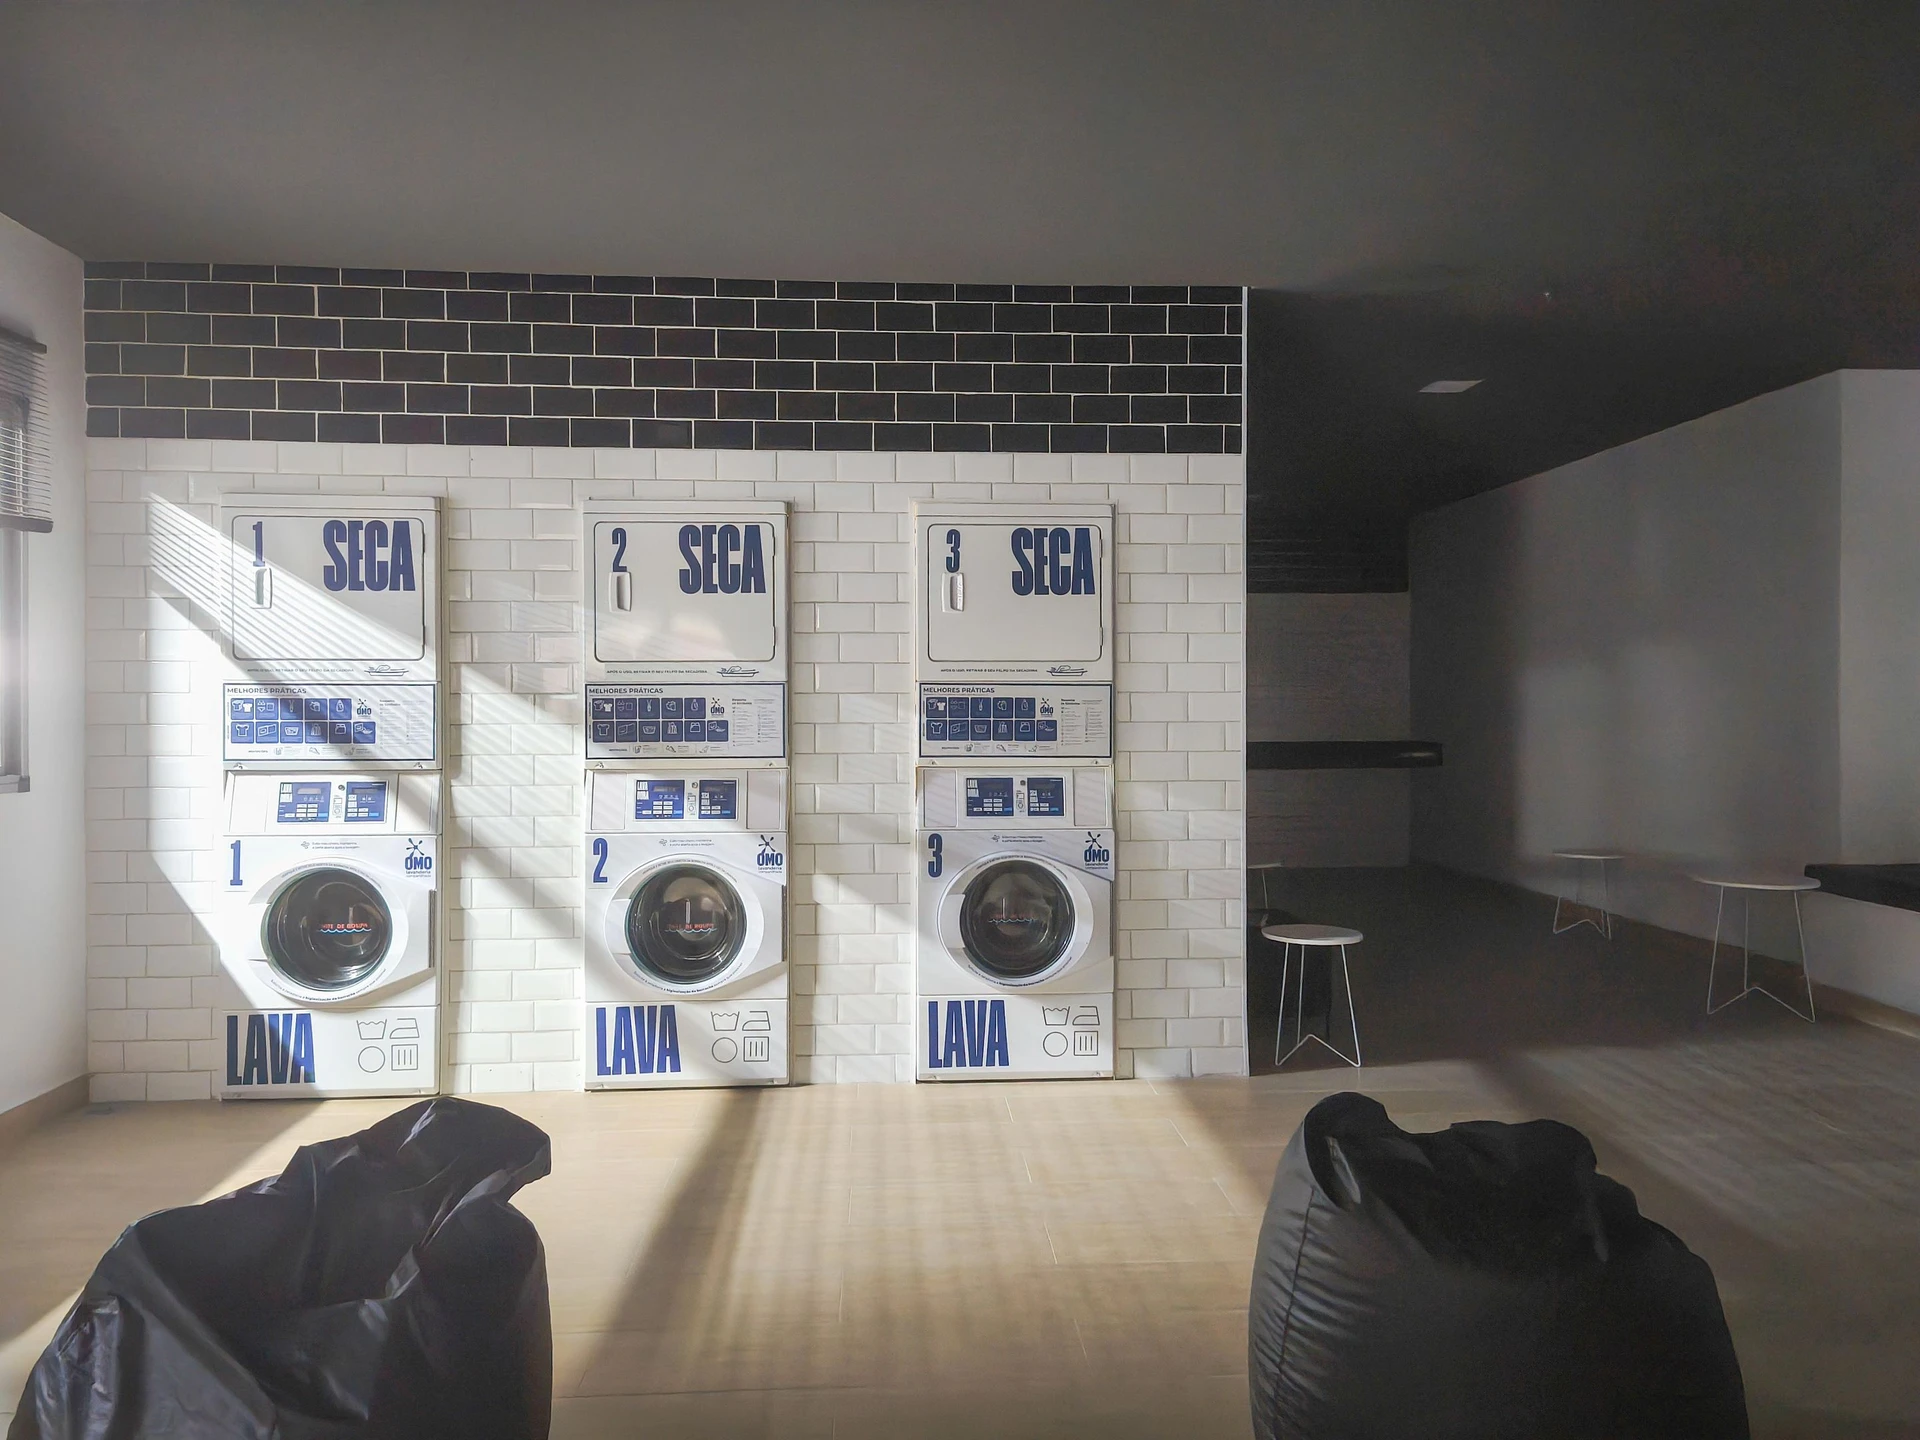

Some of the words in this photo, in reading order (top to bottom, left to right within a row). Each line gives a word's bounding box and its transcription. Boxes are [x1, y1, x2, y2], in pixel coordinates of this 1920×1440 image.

[252, 521, 266, 567] 1
[323, 520, 416, 592] SECA
[611, 527, 628, 572] 2
[678, 524, 767, 594] SECA
[945, 529, 961, 573] 3
[1011, 527, 1096, 596] SECA
[269, 686, 307, 694] PRÁTICAS
[628, 686, 664, 694] PRÁTICAS
[961, 686, 996, 694] PRÁTICAS
[229, 840, 243, 886] 1
[404, 856, 433, 870] OMO
[592, 837, 608, 883] 2
[756, 852, 784, 866] OMO
[927, 833, 943, 878] 3
[1083, 849, 1110, 863] OMO
[226, 1013, 316, 1086] LAVA
[595, 1004, 681, 1076] LAVA
[928, 999, 1010, 1068] LAVA
